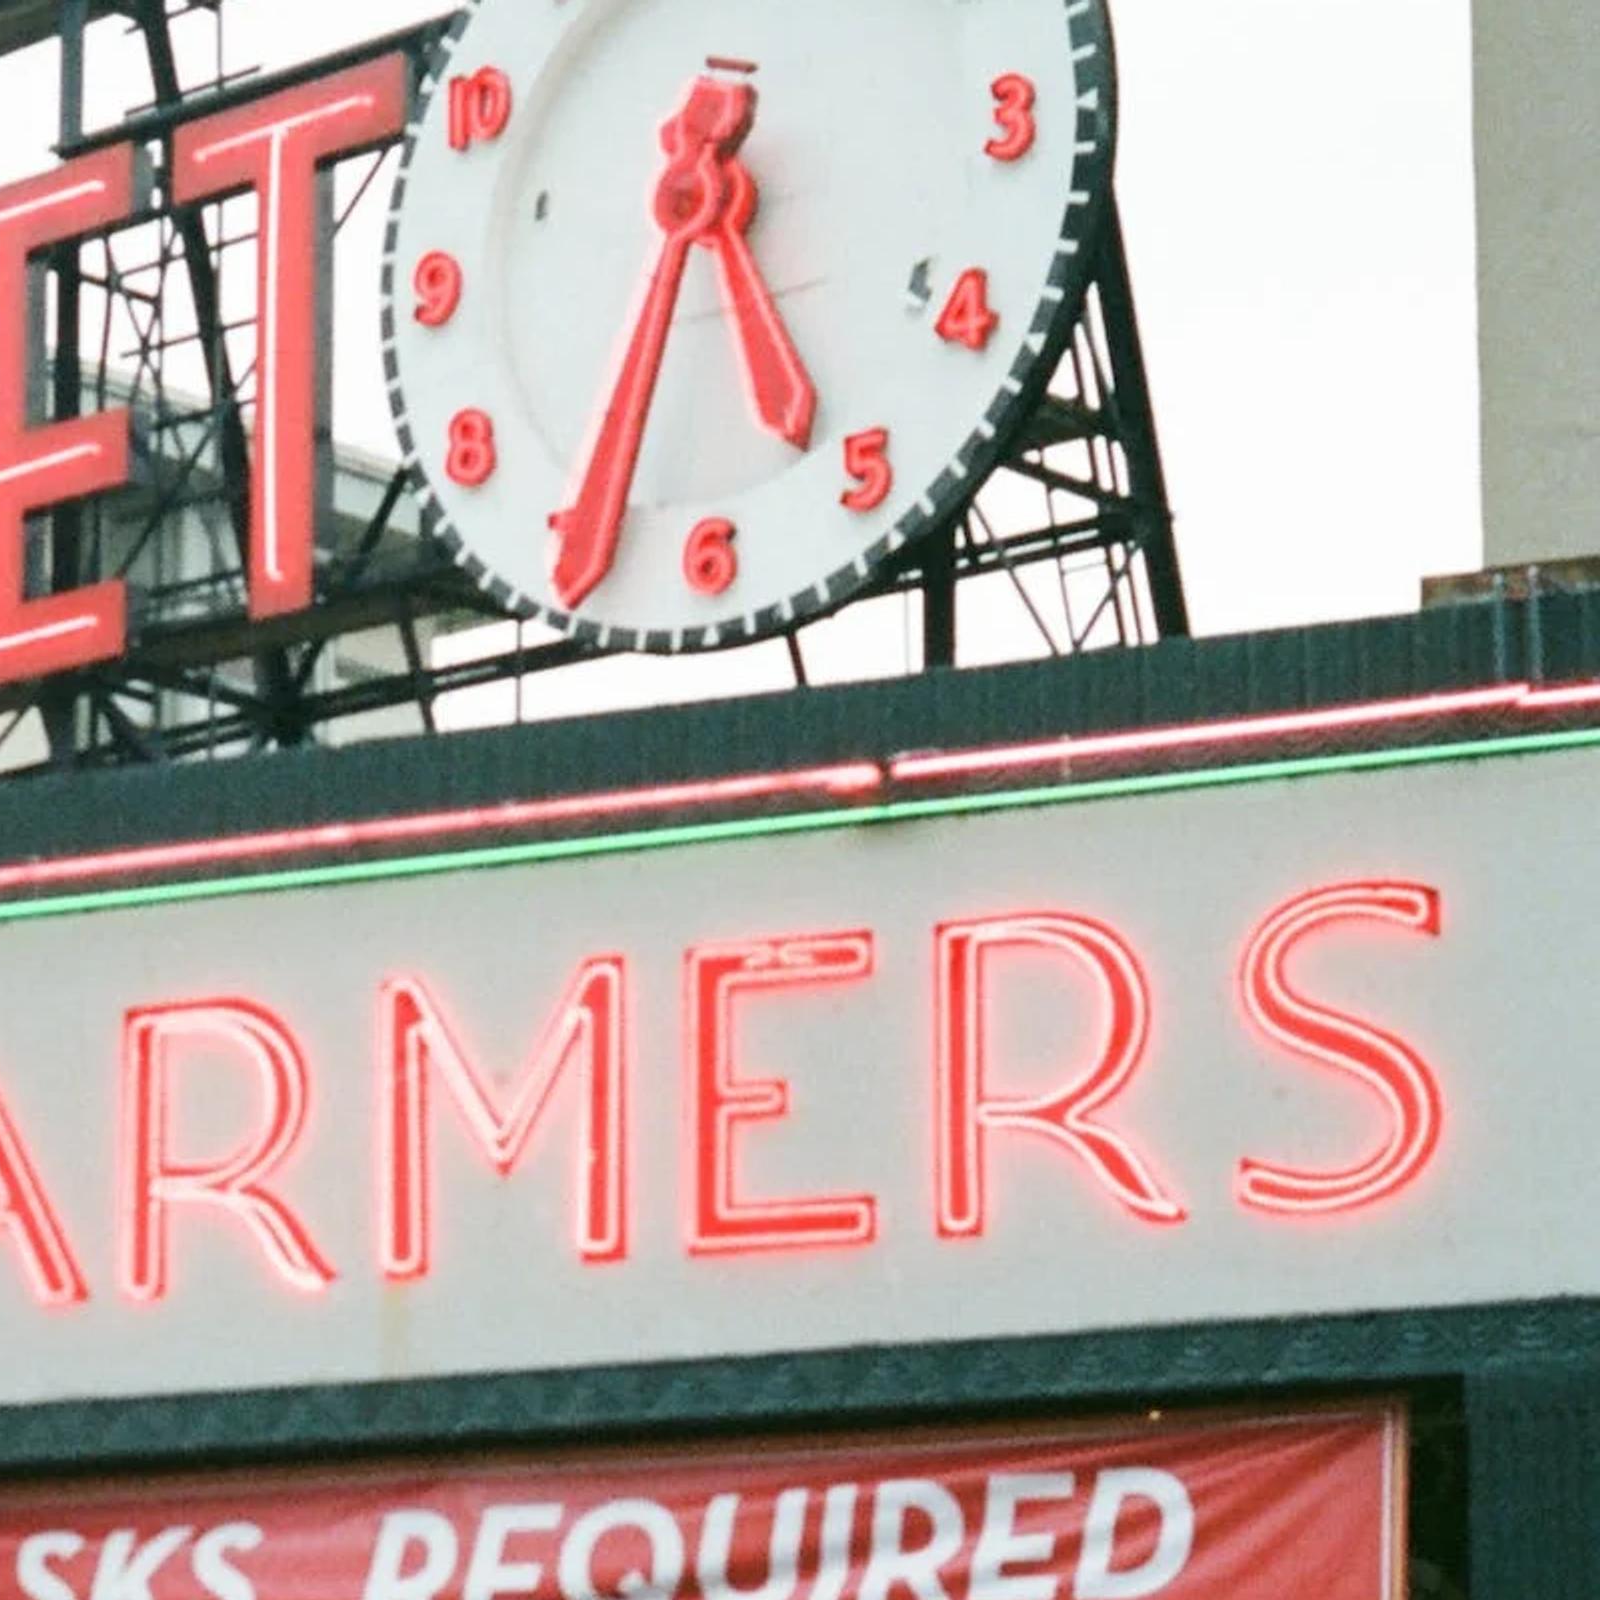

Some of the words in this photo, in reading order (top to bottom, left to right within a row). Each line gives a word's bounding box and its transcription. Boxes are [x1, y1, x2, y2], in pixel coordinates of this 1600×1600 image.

[447, 66, 512, 152] 10
[983, 72, 1036, 162] 3
[412, 250, 463, 327] 9
[933, 266, 1000, 353] 4
[444, 408, 497, 487] 8
[838, 426, 893, 512] 5
[681, 517, 739, 597] 6
